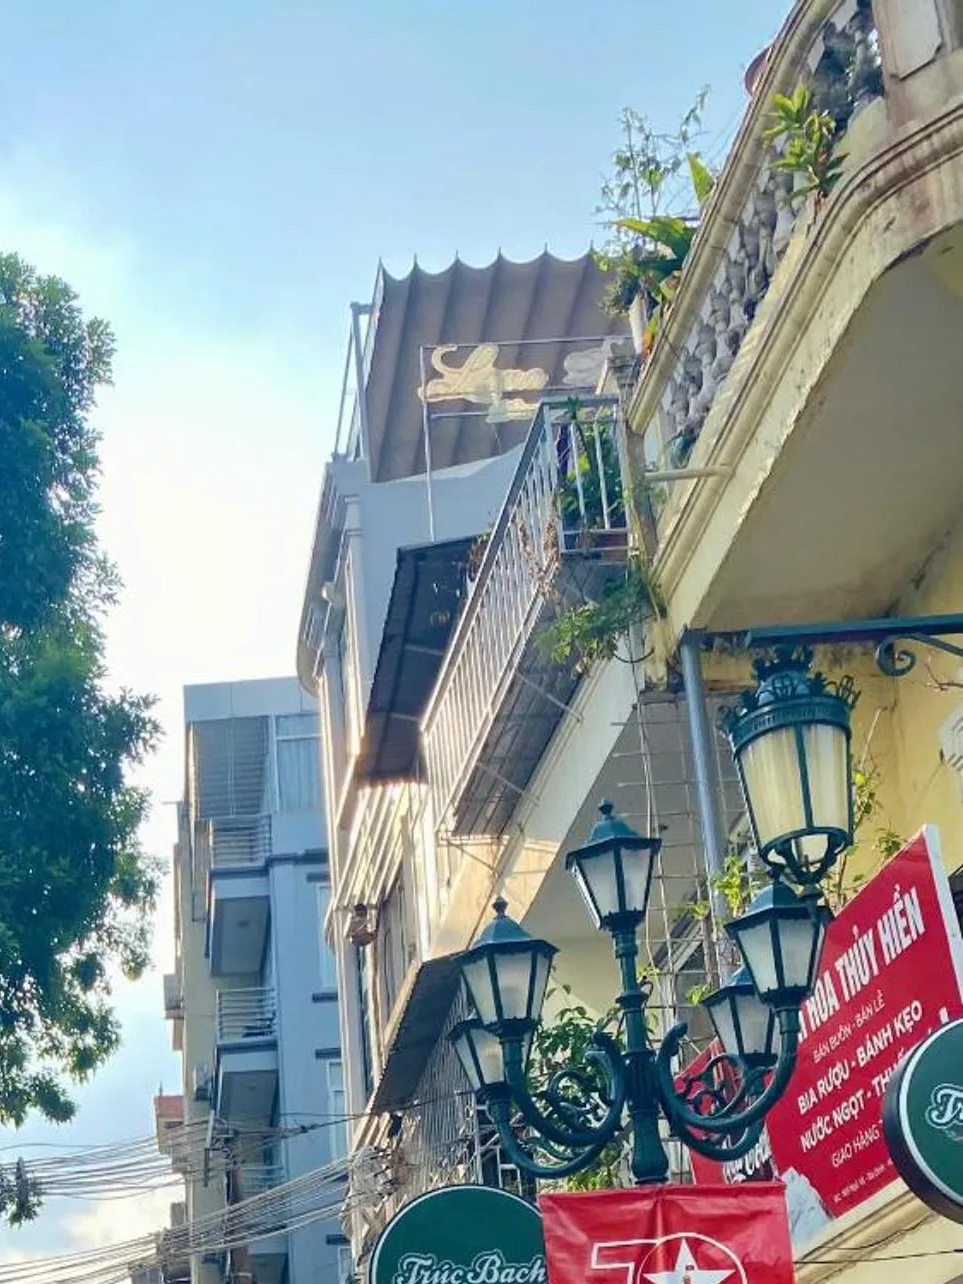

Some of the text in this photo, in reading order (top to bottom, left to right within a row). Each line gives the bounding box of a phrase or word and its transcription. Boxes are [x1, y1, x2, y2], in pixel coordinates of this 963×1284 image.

[834, 924, 879, 1003] THỦY
[877, 883, 926, 967] HIỀN
[797, 1088, 818, 1115] BIA
[816, 1059, 850, 1101] RƯỢU
[856, 1023, 895, 1068] BÁNH
[893, 1000, 923, 1038] KẸO
[800, 1114, 833, 1153] NƯỚC
[832, 1087, 866, 1129] NGỌT
[832, 1123, 881, 1167] GIAO HÀNG
